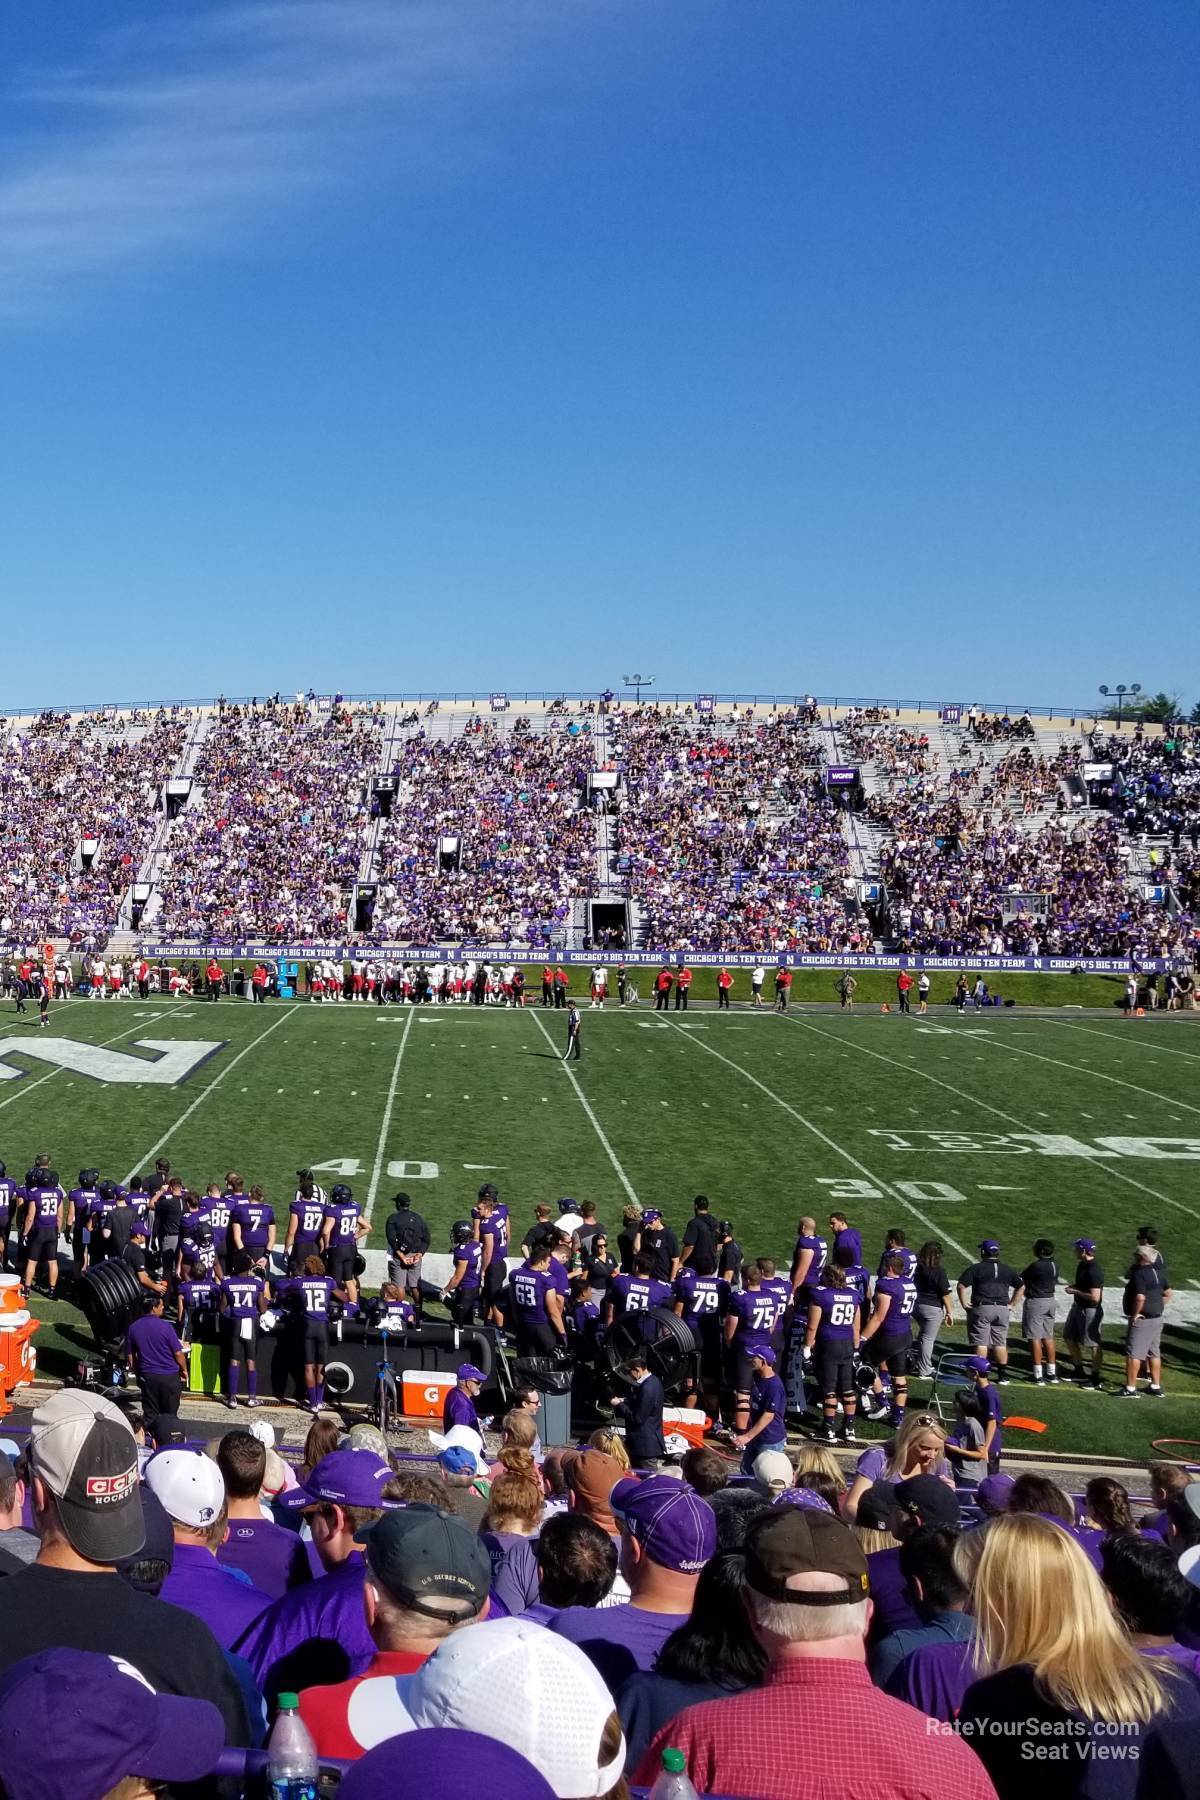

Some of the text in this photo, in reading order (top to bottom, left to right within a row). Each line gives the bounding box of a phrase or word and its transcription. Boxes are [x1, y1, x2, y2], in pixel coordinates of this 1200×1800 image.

[947, 710, 958, 719] 111
[143, 947, 148, 955] N
[241, 948, 247, 956] N
[343, 949, 440, 958] N CHICAGO'S BIG TEN TEAM
[448, 951, 549, 960] N CHICAGO'S BIG TEN TEAM
[557, 953, 662, 961] N CHICAGO'S BIG TEN TEAM
[670, 954, 779, 963] N CHICAGO'S BIG TEN TEAM
[787, 955, 899, 965] N CHICAGO'S BIG TEN TEAM
[907, 958, 1025, 967] N CHICAGO'S BIG TEN TEAM
[1034, 960, 1042, 969] N
[309, 1157, 439, 1179] 40
[815, 1177, 968, 1201] 30
[40, 1199, 58, 1216] 33
[211, 1208, 230, 1227] 86
[250, 1215, 261, 1232] 7
[303, 1212, 323, 1231] 87
[340, 1216, 358, 1236] 84
[232, 1291, 253, 1308] 14
[305, 1289, 325, 1311] 12
[515, 1283, 537, 1307] 63
[625, 1292, 648, 1311] 61
[692, 1290, 719, 1313] 79
[753, 1306, 775, 1329] 75
[831, 1303, 855, 1325] 69
[423, 1386, 440, 1403] G
[91, 1467, 137, 1493] CCM
[95, 1486, 133, 1504] HOCKEY
[434, 1573, 456, 1582] SECRET
[457, 1577, 476, 1592] SERVICE
